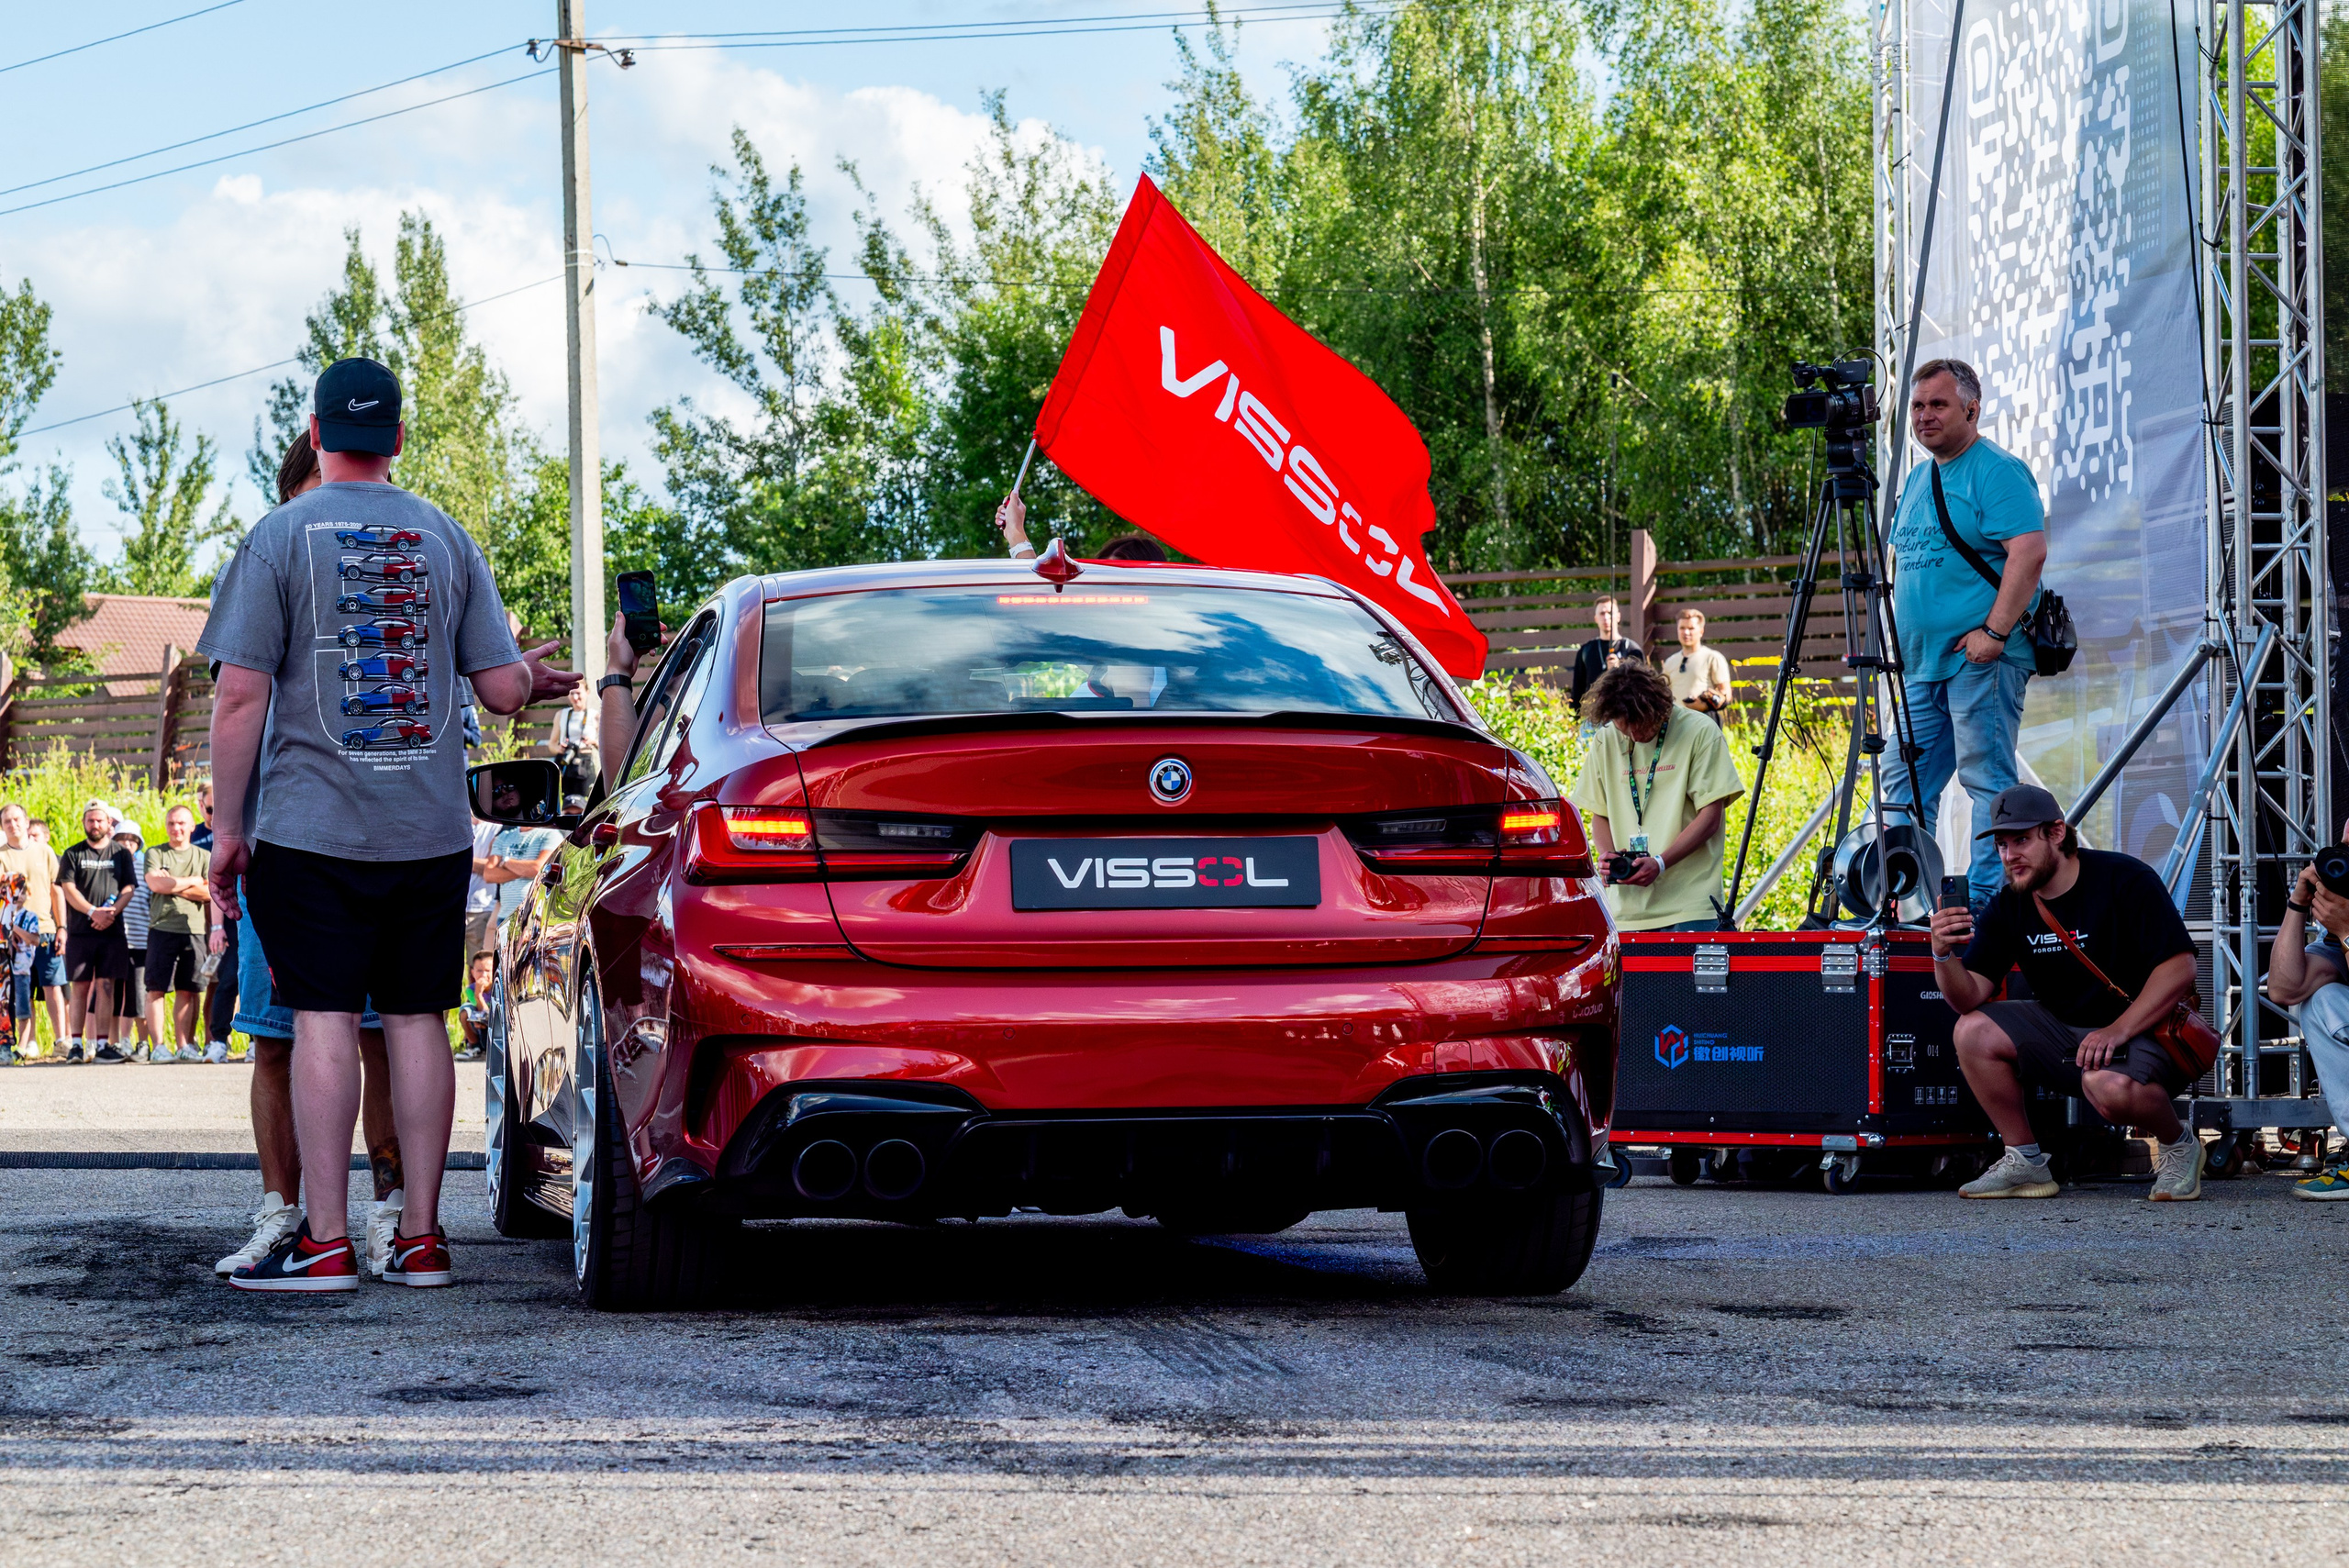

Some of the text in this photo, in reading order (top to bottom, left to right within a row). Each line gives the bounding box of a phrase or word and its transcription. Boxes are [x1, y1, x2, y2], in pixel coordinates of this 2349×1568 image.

[1160, 325, 1451, 618] VISSOL
[364, 750, 397, 758] generations,
[1047, 856, 1289, 889] VISSOL
[2026, 929, 2088, 946] VISOL
[2033, 946, 2062, 954] FORGED
[1927, 1044, 1939, 1057] 014
